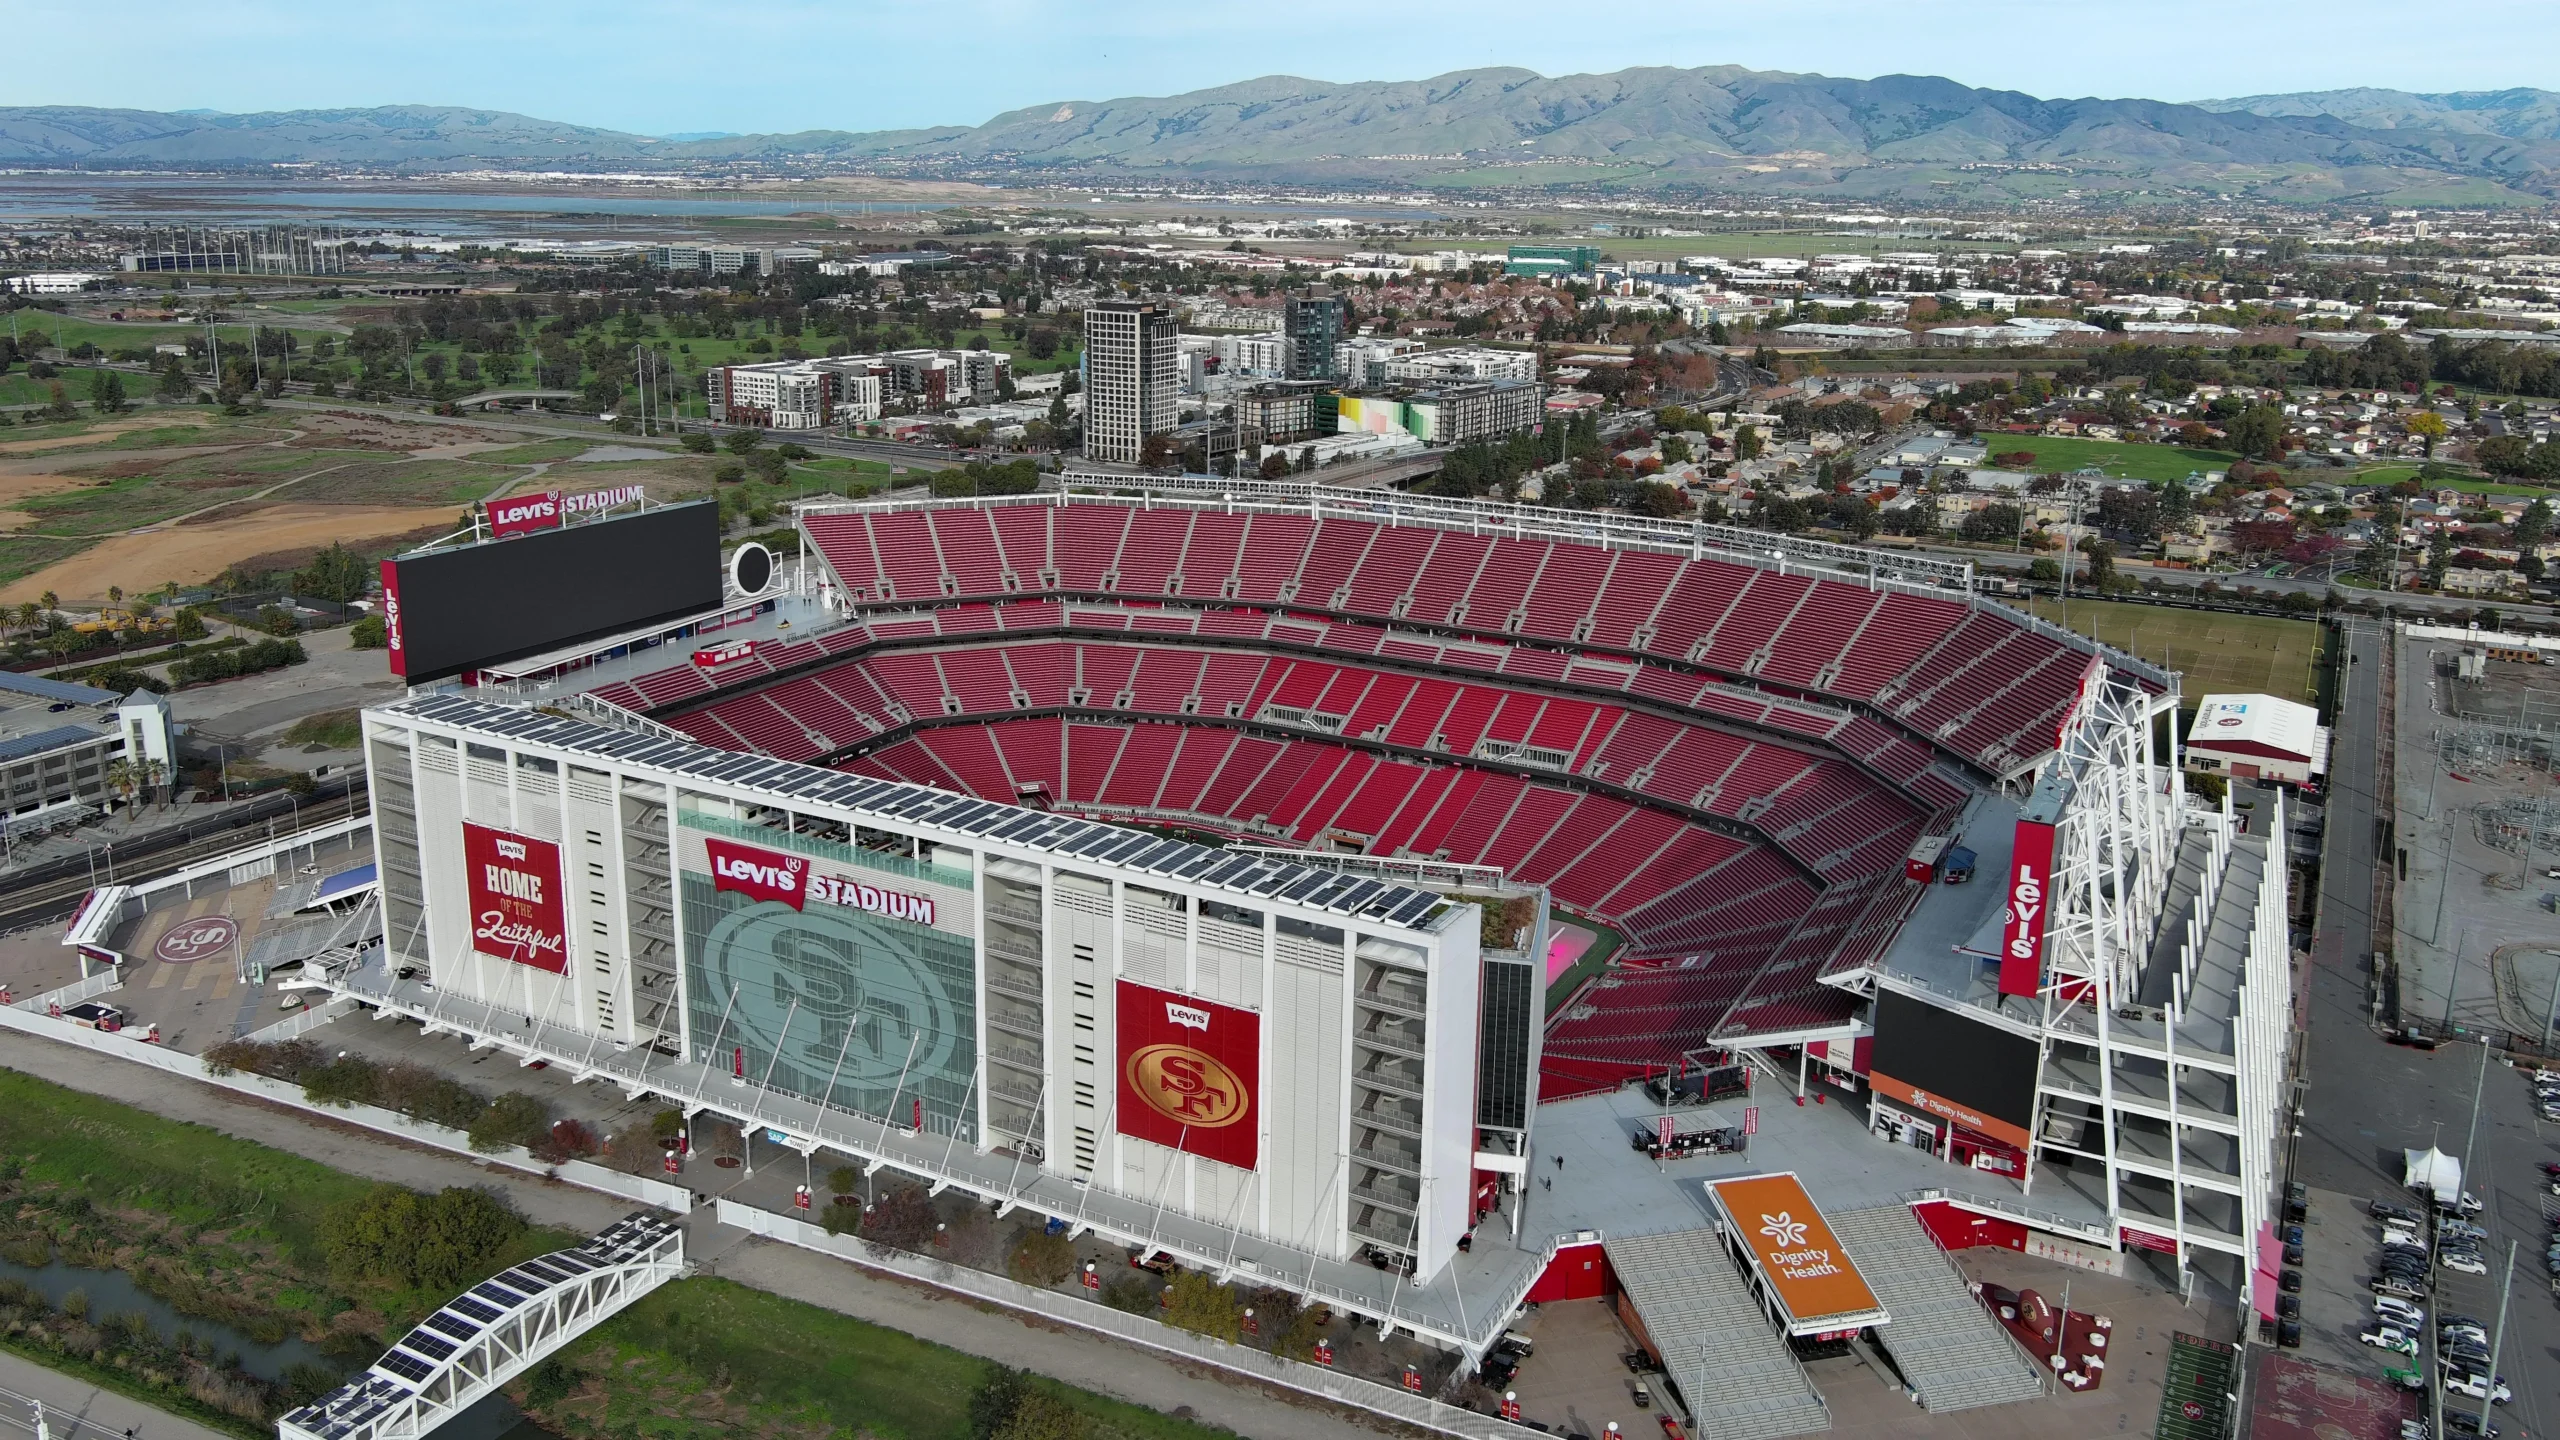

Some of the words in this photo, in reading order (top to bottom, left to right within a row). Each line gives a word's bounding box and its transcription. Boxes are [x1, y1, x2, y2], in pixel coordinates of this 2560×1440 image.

[564, 486, 642, 513] STADIUM
[485, 863, 543, 904] HOME
[500, 897, 511, 914] OF
[514, 901, 533, 919] THE
[812, 876, 934, 925] STADIUM
[476, 910, 563, 959] Faithful
[1929, 1099, 1956, 1118] Dignity
[1956, 1110, 1982, 1126] Health
[768, 1131, 783, 1142] SAP
[1769, 1248, 1829, 1266] Dignity
[1781, 1262, 1838, 1279] Health
